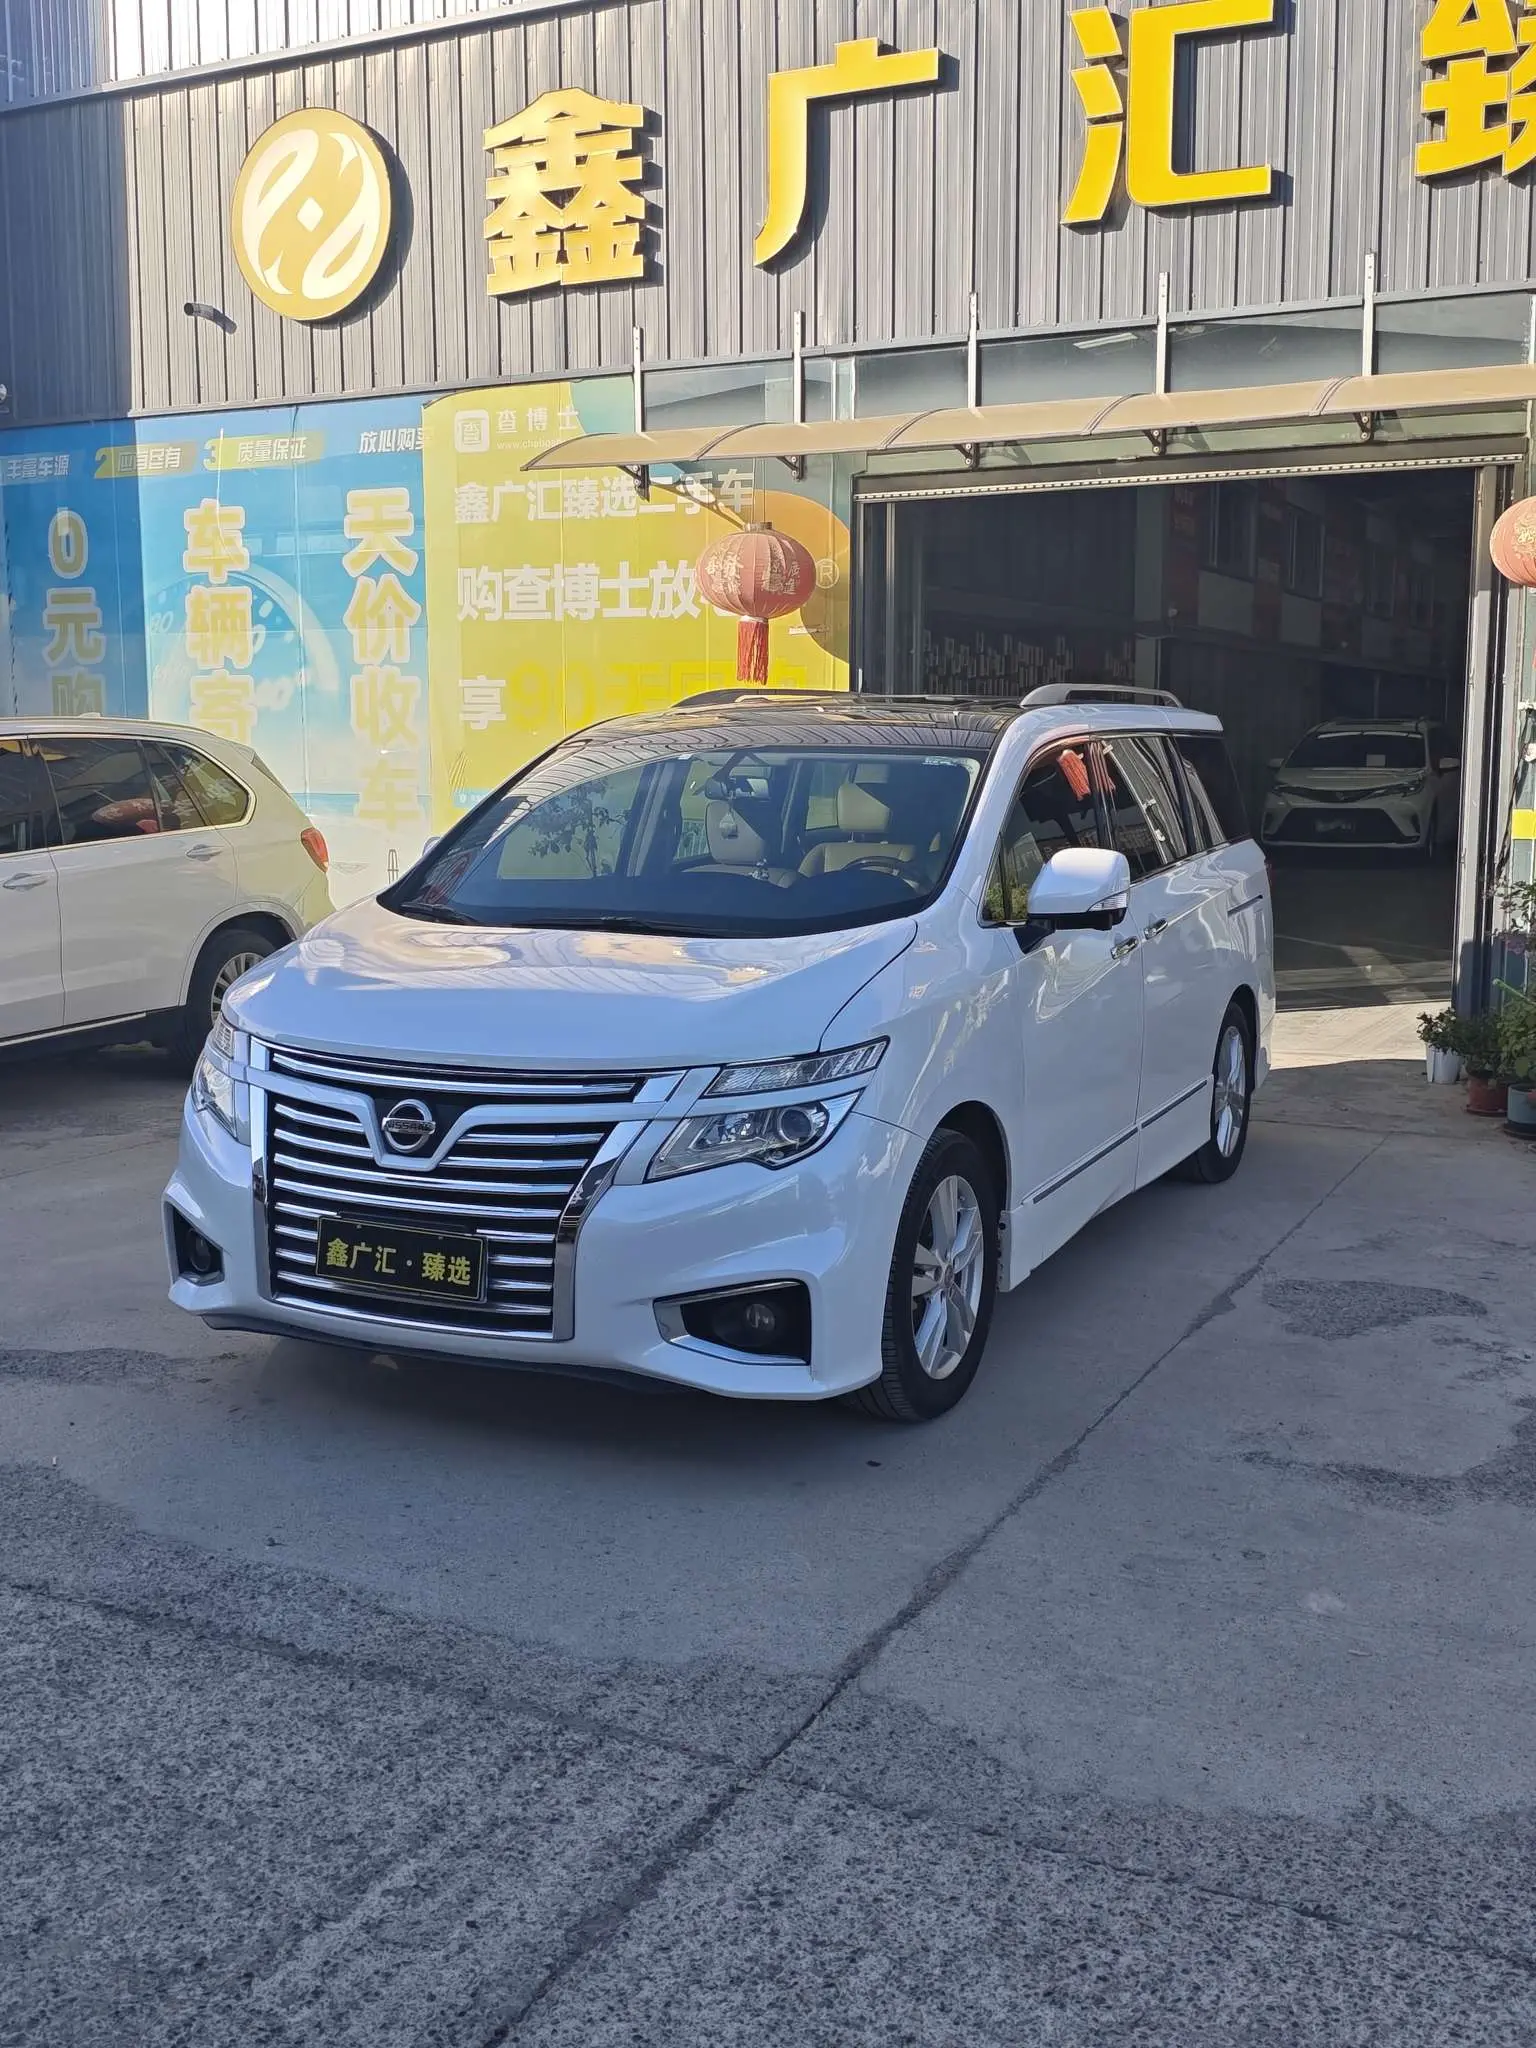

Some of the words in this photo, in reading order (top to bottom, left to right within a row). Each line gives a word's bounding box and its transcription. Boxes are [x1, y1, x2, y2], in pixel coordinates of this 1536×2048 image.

[496, 406, 579, 434] 查博士
[238, 437, 308, 464] 质量保证
[455, 469, 754, 523] 鑫广汇臻选二手车
[457, 560, 740, 622] 购查博士放
[342, 488, 422, 832] 天价收车
[385, 1119, 434, 1132] NISSAN
